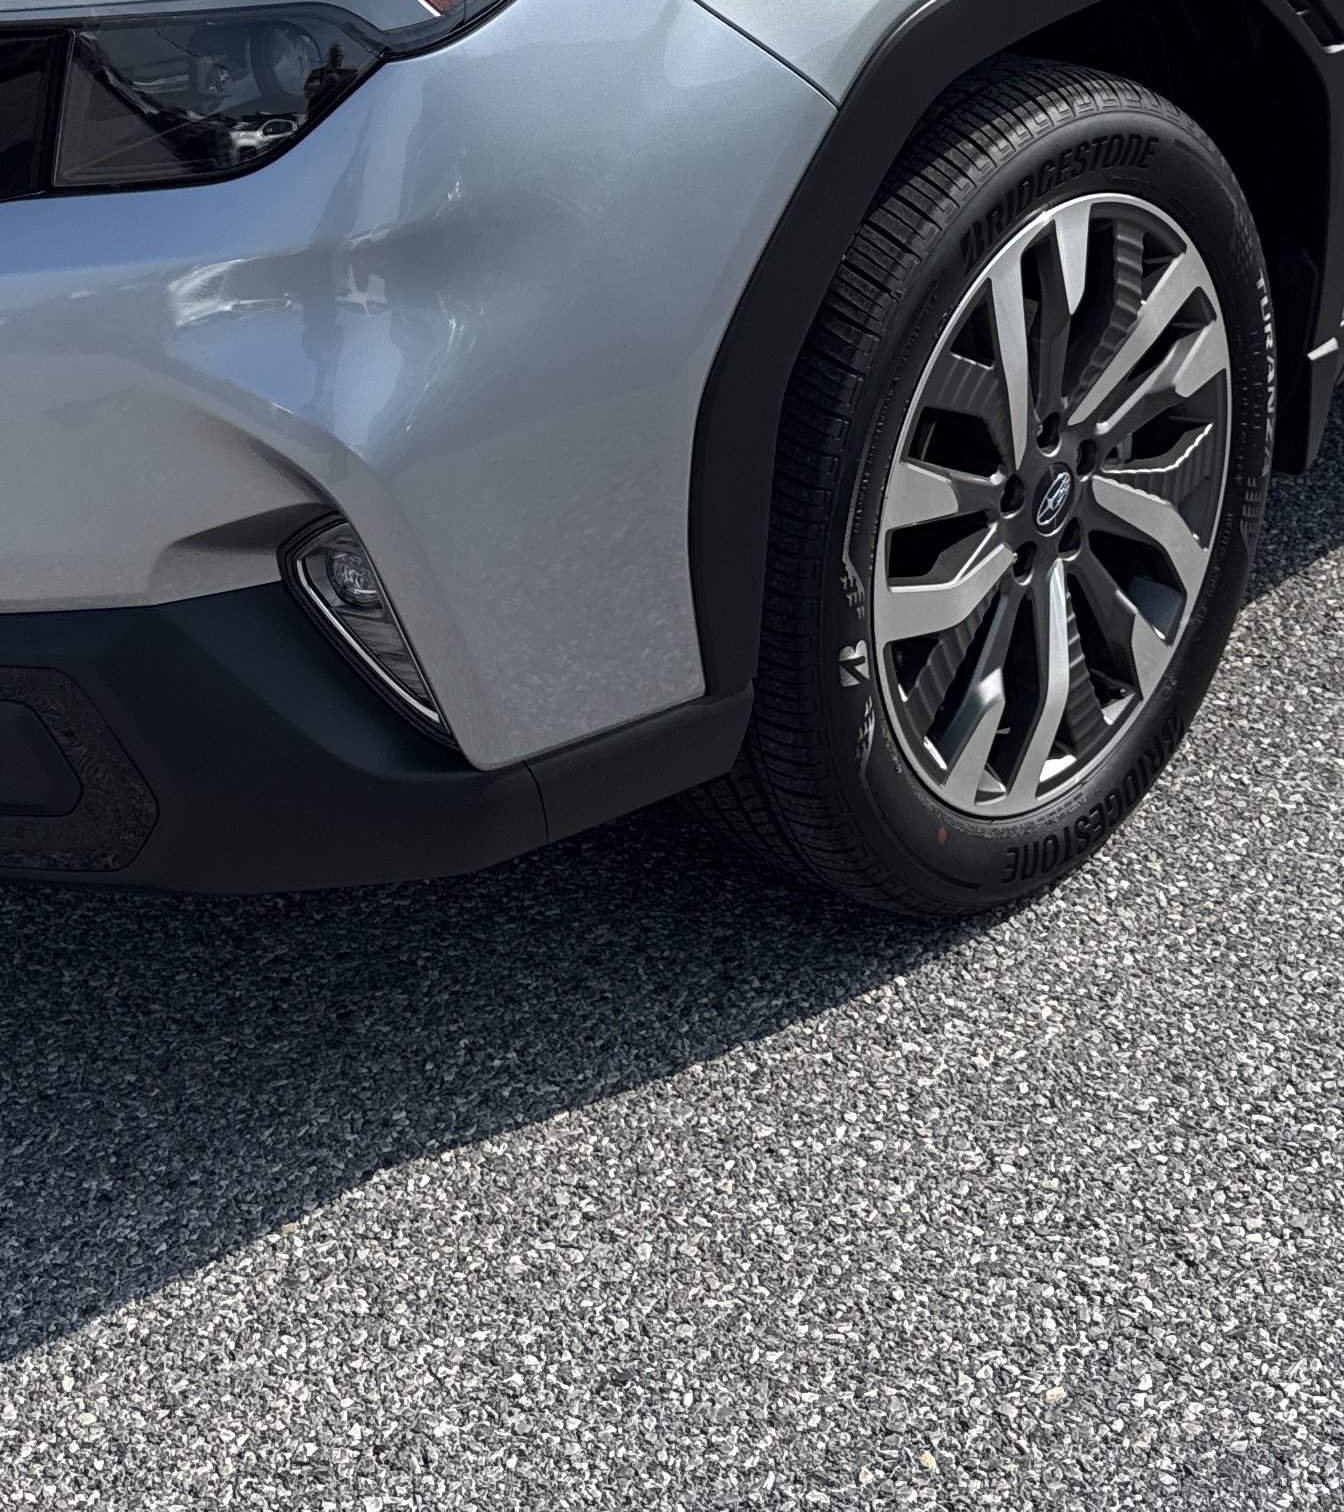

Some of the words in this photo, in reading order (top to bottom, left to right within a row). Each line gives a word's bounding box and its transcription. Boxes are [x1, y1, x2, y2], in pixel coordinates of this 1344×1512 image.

[958, 134, 1160, 275] BRIDGESTONE
[1256, 267, 1276, 478] TURANZA
[999, 713, 1188, 885] BRIDGESTONE
